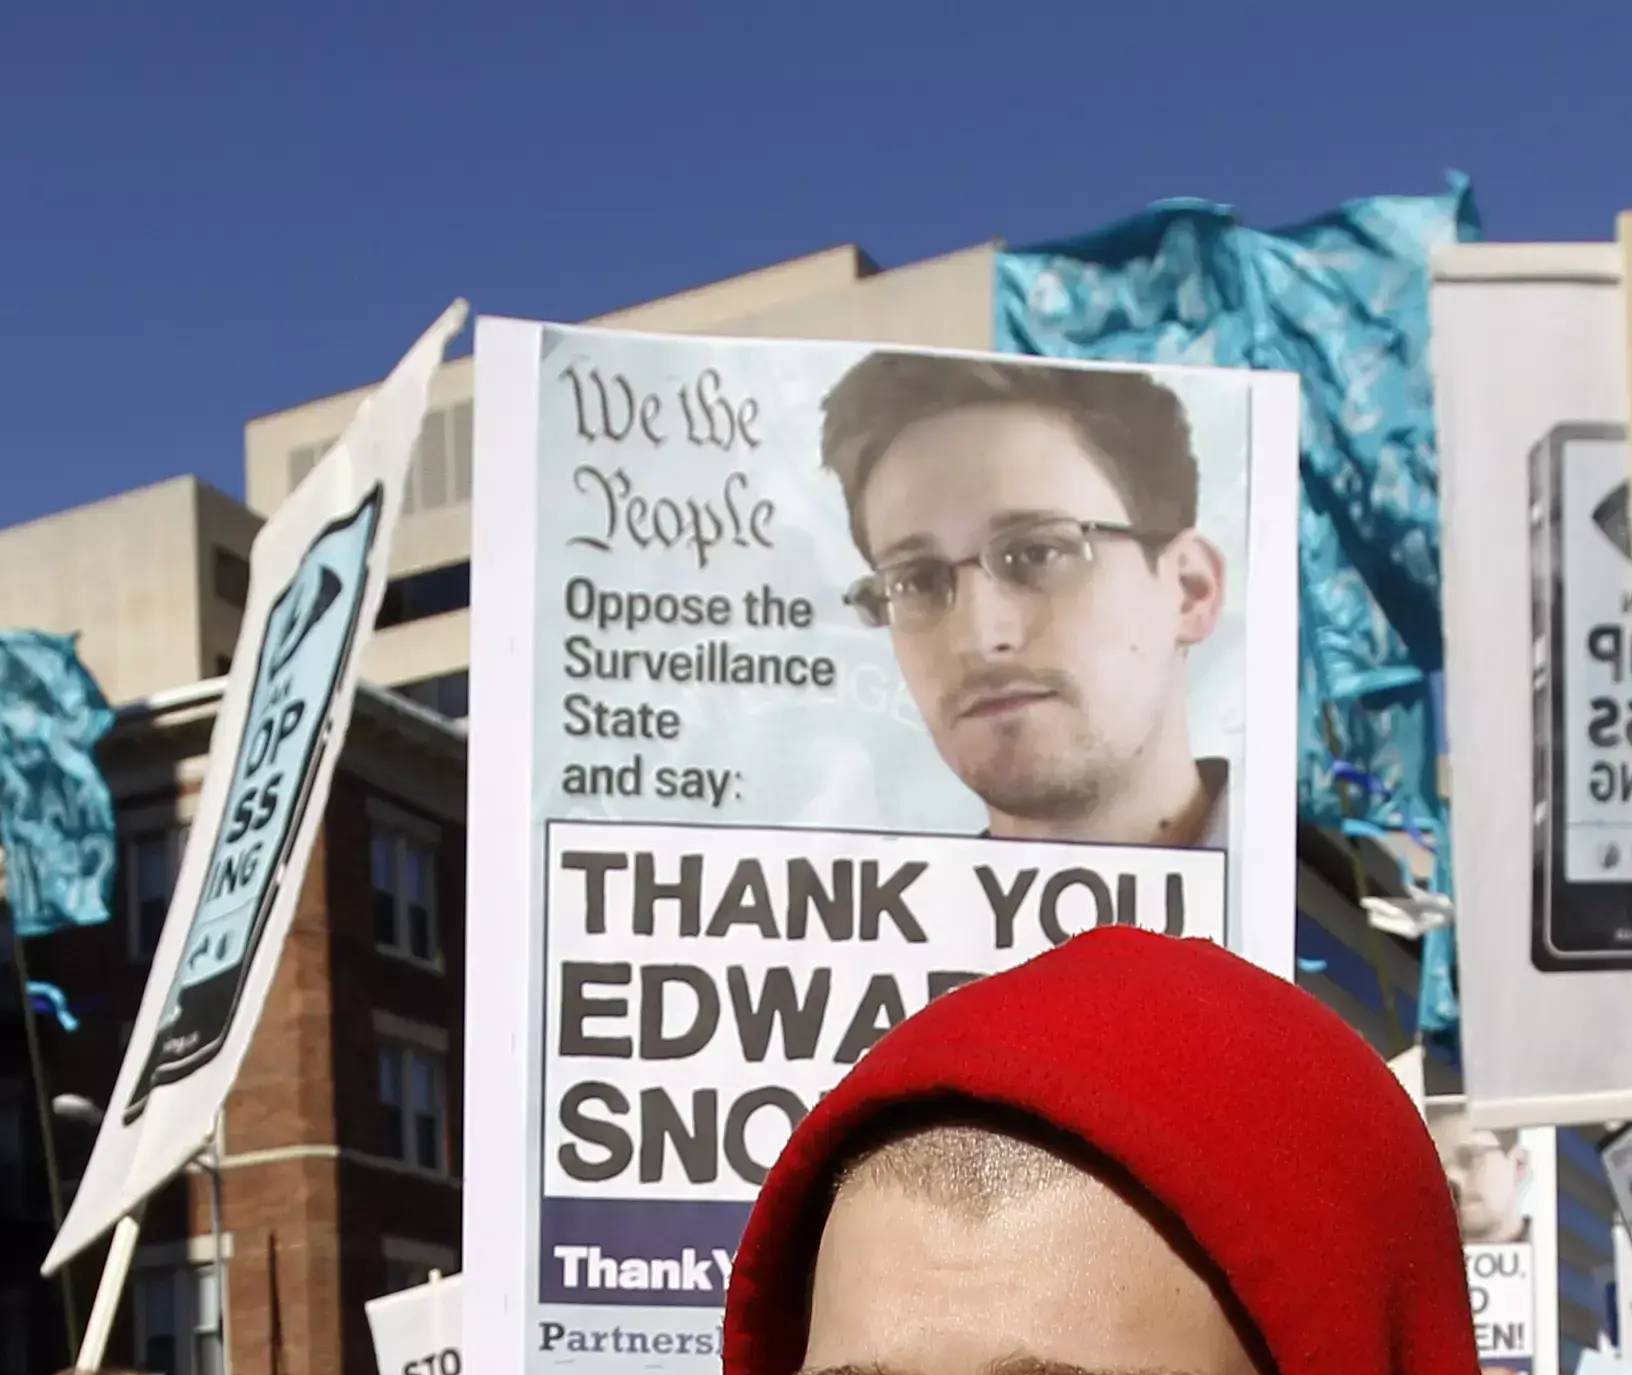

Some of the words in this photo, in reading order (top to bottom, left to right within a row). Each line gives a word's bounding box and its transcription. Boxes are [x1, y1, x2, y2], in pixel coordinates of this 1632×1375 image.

[560, 366, 667, 448] We
[680, 368, 762, 451] the
[565, 464, 776, 570] People
[565, 575, 731, 631] Oppose
[745, 583, 814, 629] the
[564, 635, 836, 687] Surveillance
[244, 700, 306, 779] OP
[563, 694, 680, 740] State
[226, 771, 285, 844] SS
[561, 753, 642, 797] and
[654, 769, 744, 808] say:
[205, 841, 263, 903] ING
[561, 850, 929, 944] THANK
[558, 960, 992, 1064] EDWA
[557, 1080, 816, 1186] SNO
[539, 1320, 723, 1355] Partners
[1475, 1322, 1525, 1351] EN!
